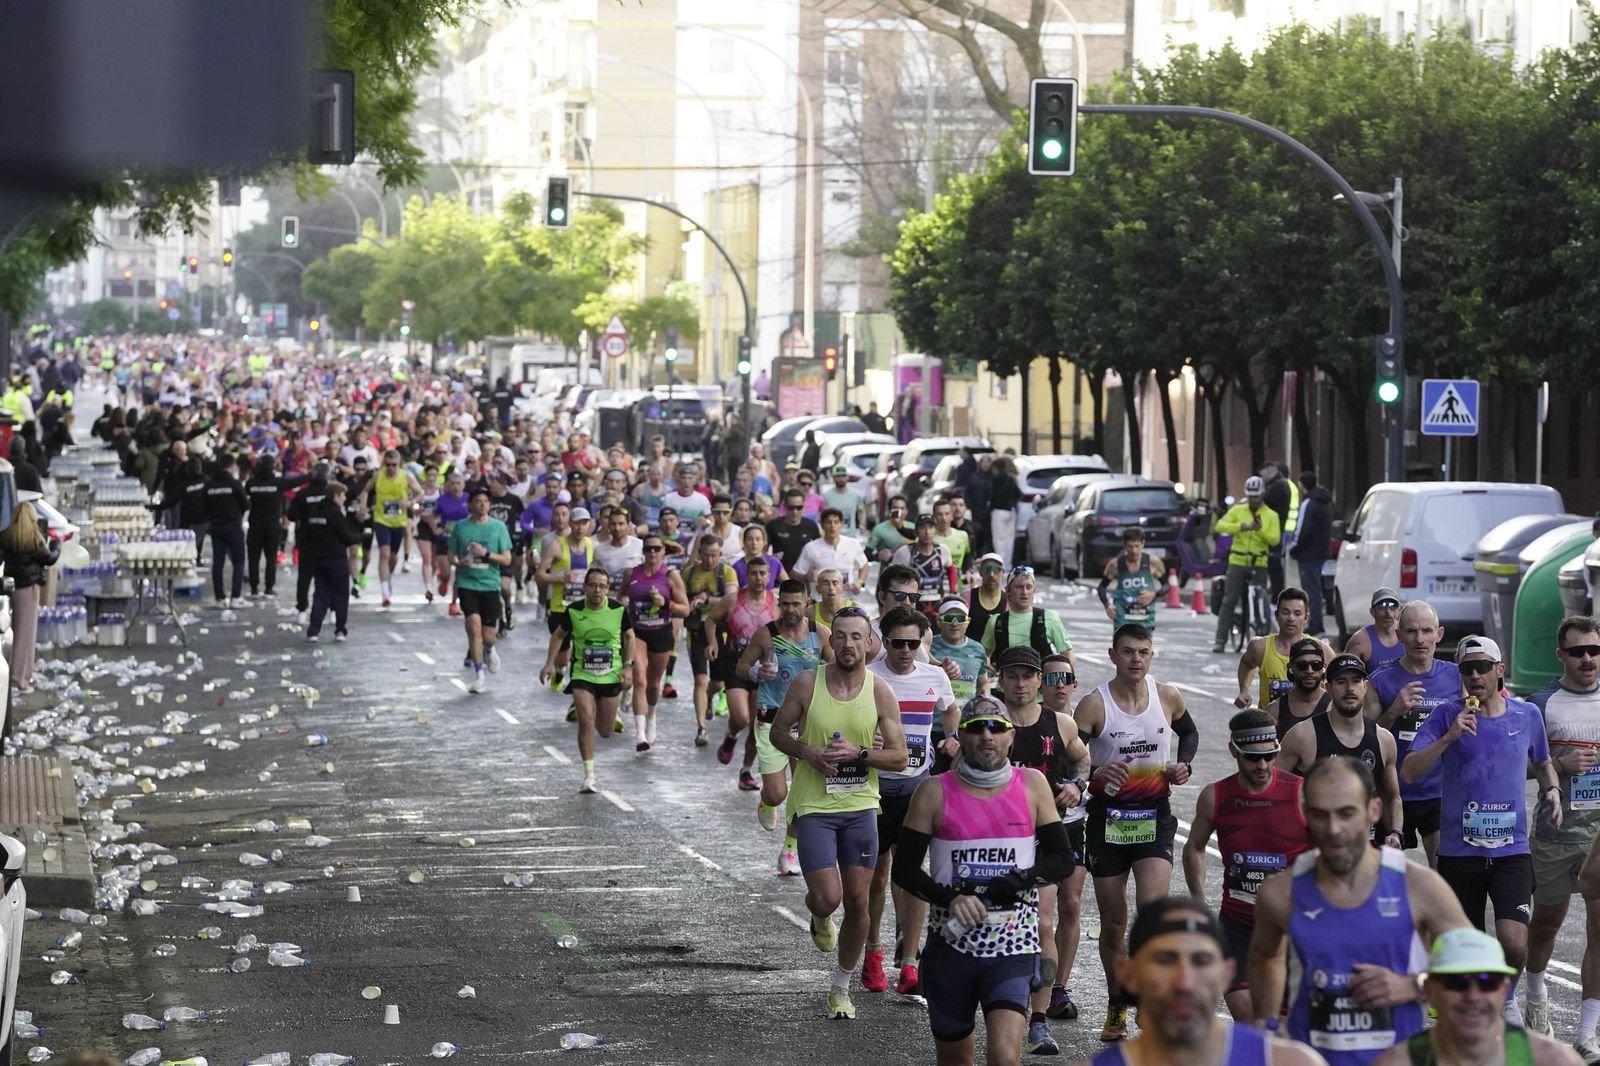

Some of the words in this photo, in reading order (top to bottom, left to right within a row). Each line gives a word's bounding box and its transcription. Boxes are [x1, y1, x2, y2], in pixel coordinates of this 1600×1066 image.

[1119, 744, 1158, 754] MARATHON
[1481, 803, 1511, 811] ZURICH
[1463, 826, 1482, 837] DEL
[1485, 826, 1515, 838] CERRO
[1105, 833, 1134, 843] RAMÓN
[1135, 834, 1155, 842] BORT
[951, 847, 1016, 863] ENTRENA
[1246, 856, 1280, 864] ZURICH
[1246, 872, 1265, 880] 4653
[1326, 1012, 1372, 1031] JULIO
